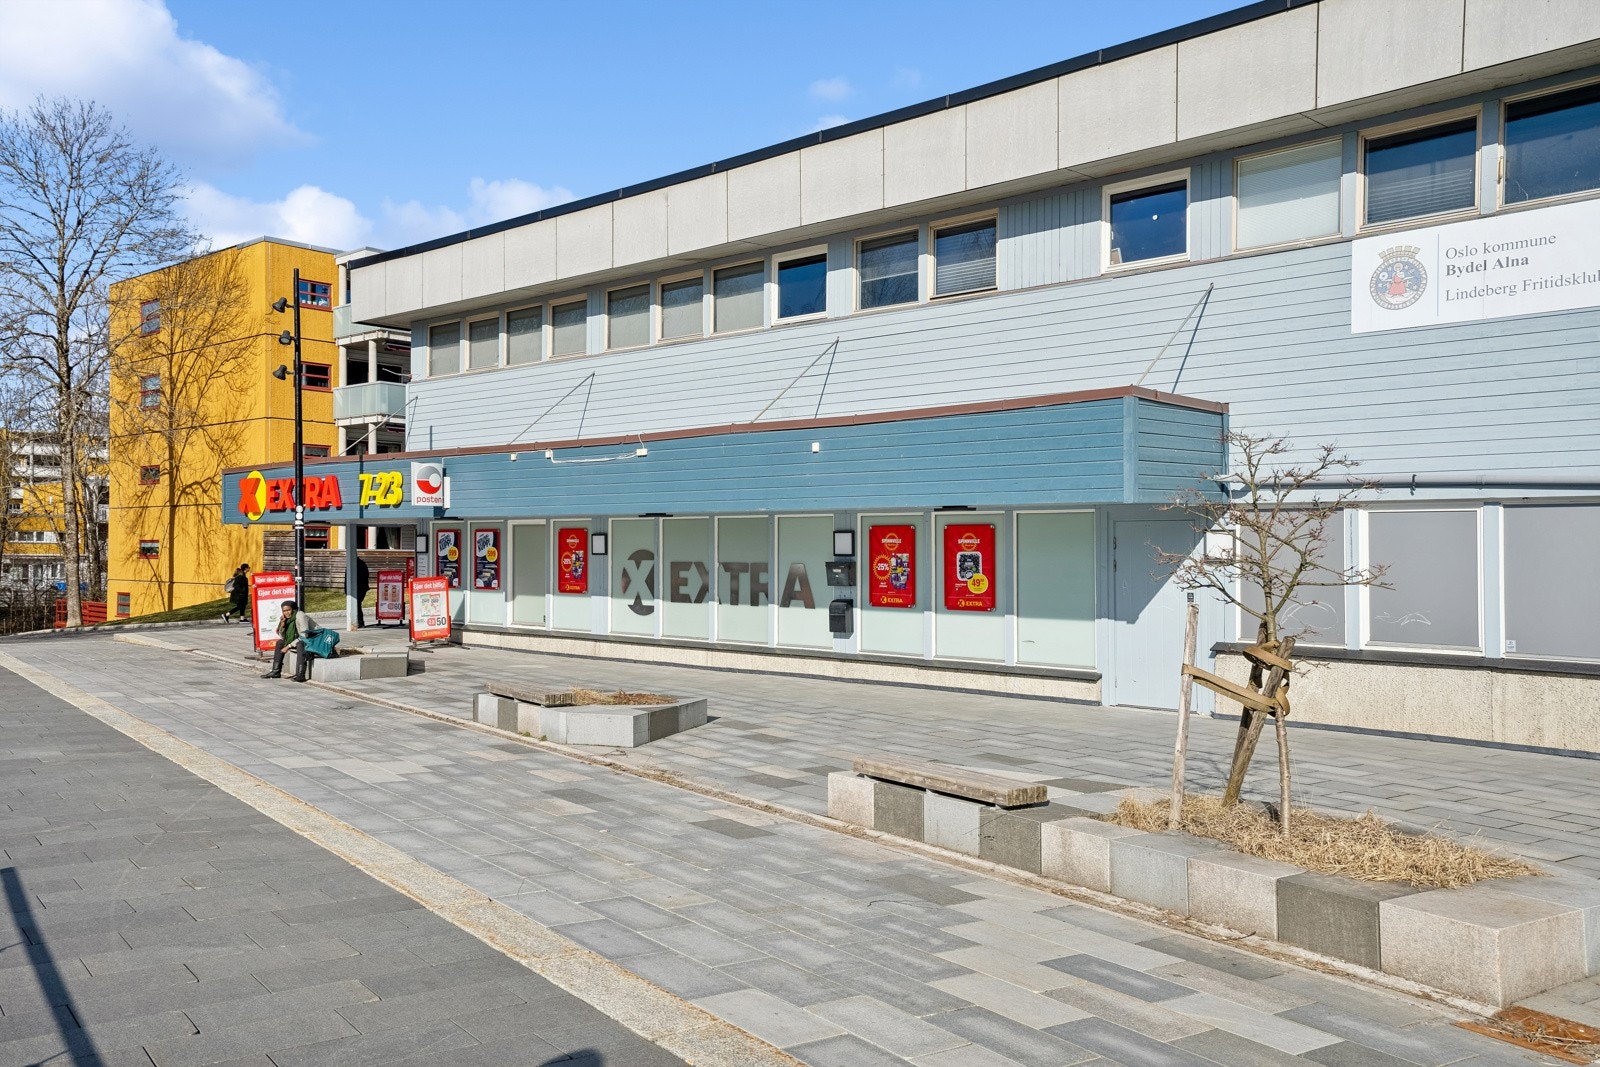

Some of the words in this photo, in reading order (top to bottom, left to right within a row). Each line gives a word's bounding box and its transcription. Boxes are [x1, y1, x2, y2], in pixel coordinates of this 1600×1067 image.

[1445, 245, 1478, 260] Oslo
[1483, 235, 1556, 254] kommune
[1446, 260, 1487, 277] Bydel
[1492, 256, 1529, 270] Alna
[1446, 285, 1518, 301] Lindeberg
[1522, 269, 1600, 292] Fritidsklu
[266, 475, 342, 511] EXRA
[358, 471, 403, 506] 7-23
[416, 496, 442, 504] posten
[257, 589, 270, 597] Gjør
[670, 561, 816, 609] EXTRA
[436, 616, 447, 626] 50
